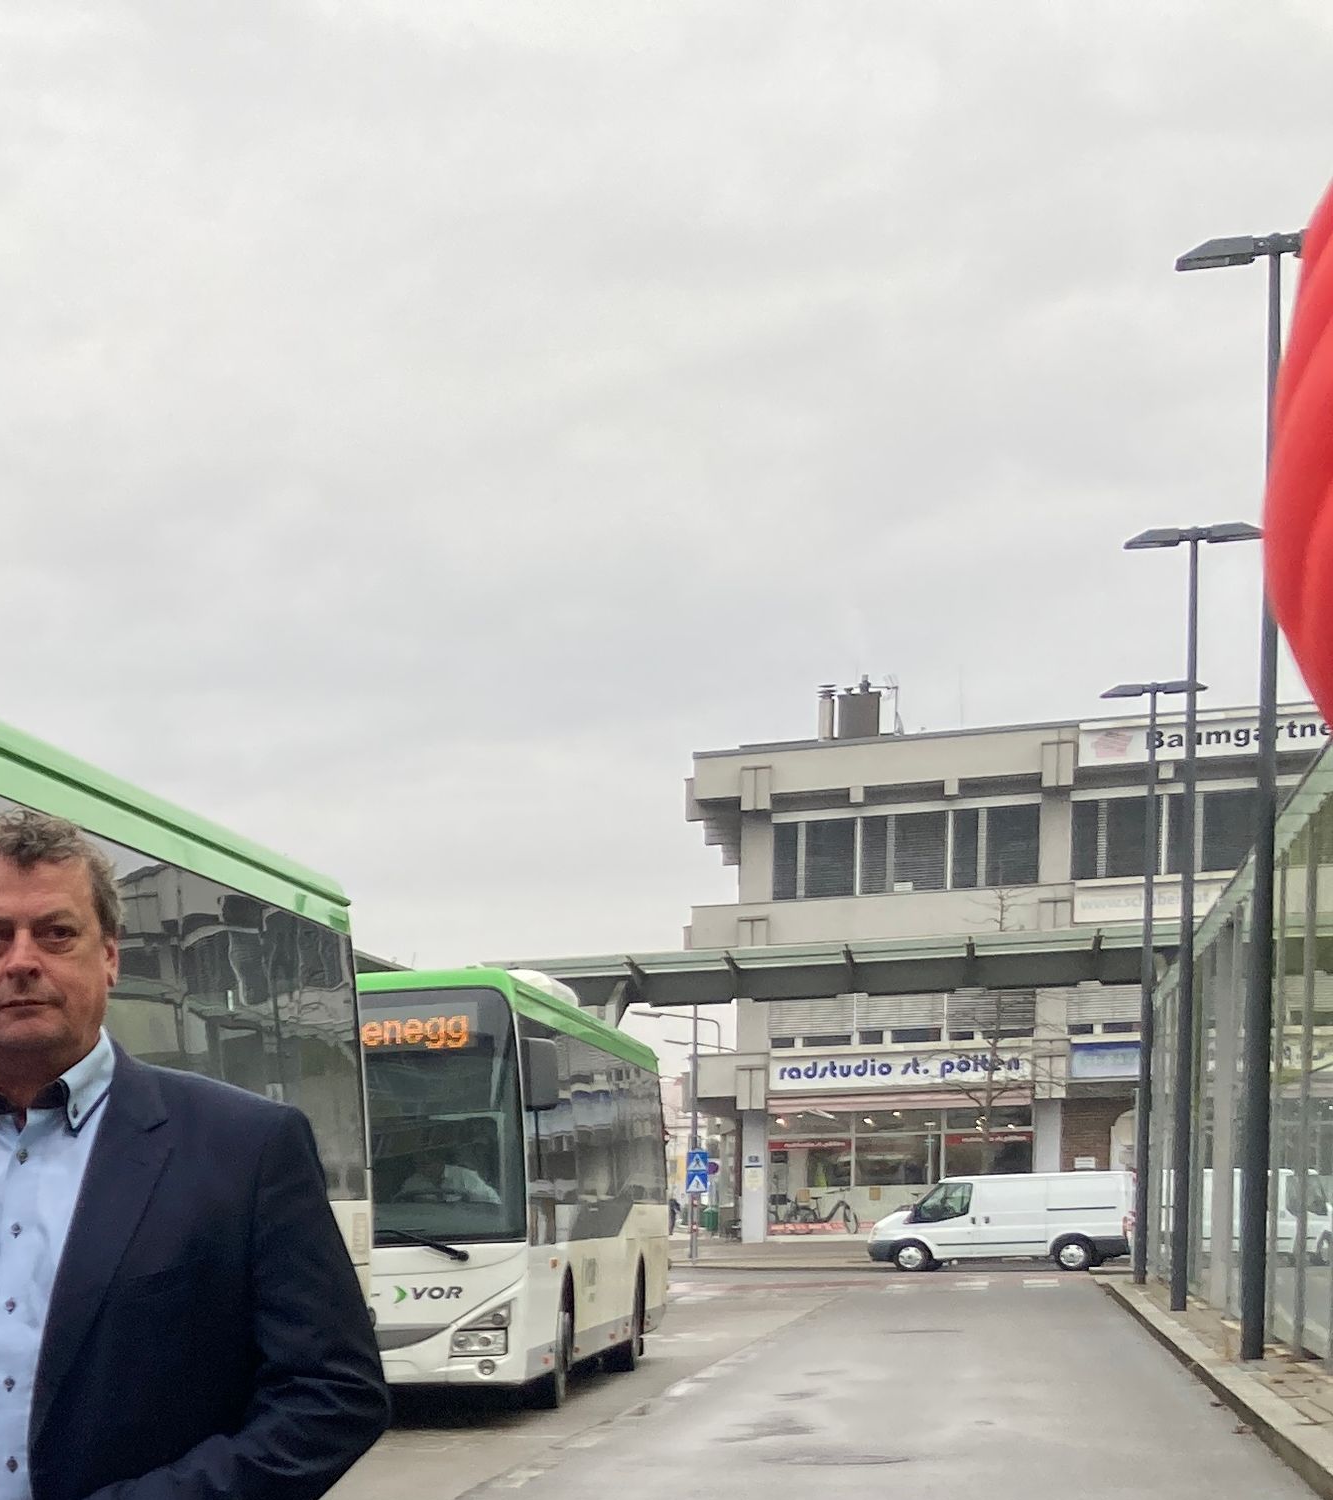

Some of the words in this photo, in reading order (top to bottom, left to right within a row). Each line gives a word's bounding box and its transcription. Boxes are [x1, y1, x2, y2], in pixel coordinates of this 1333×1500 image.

[779, 1059, 892, 1080] radstudio
[901, 1057, 929, 1075] st.
[411, 1286, 463, 1300] VOR
